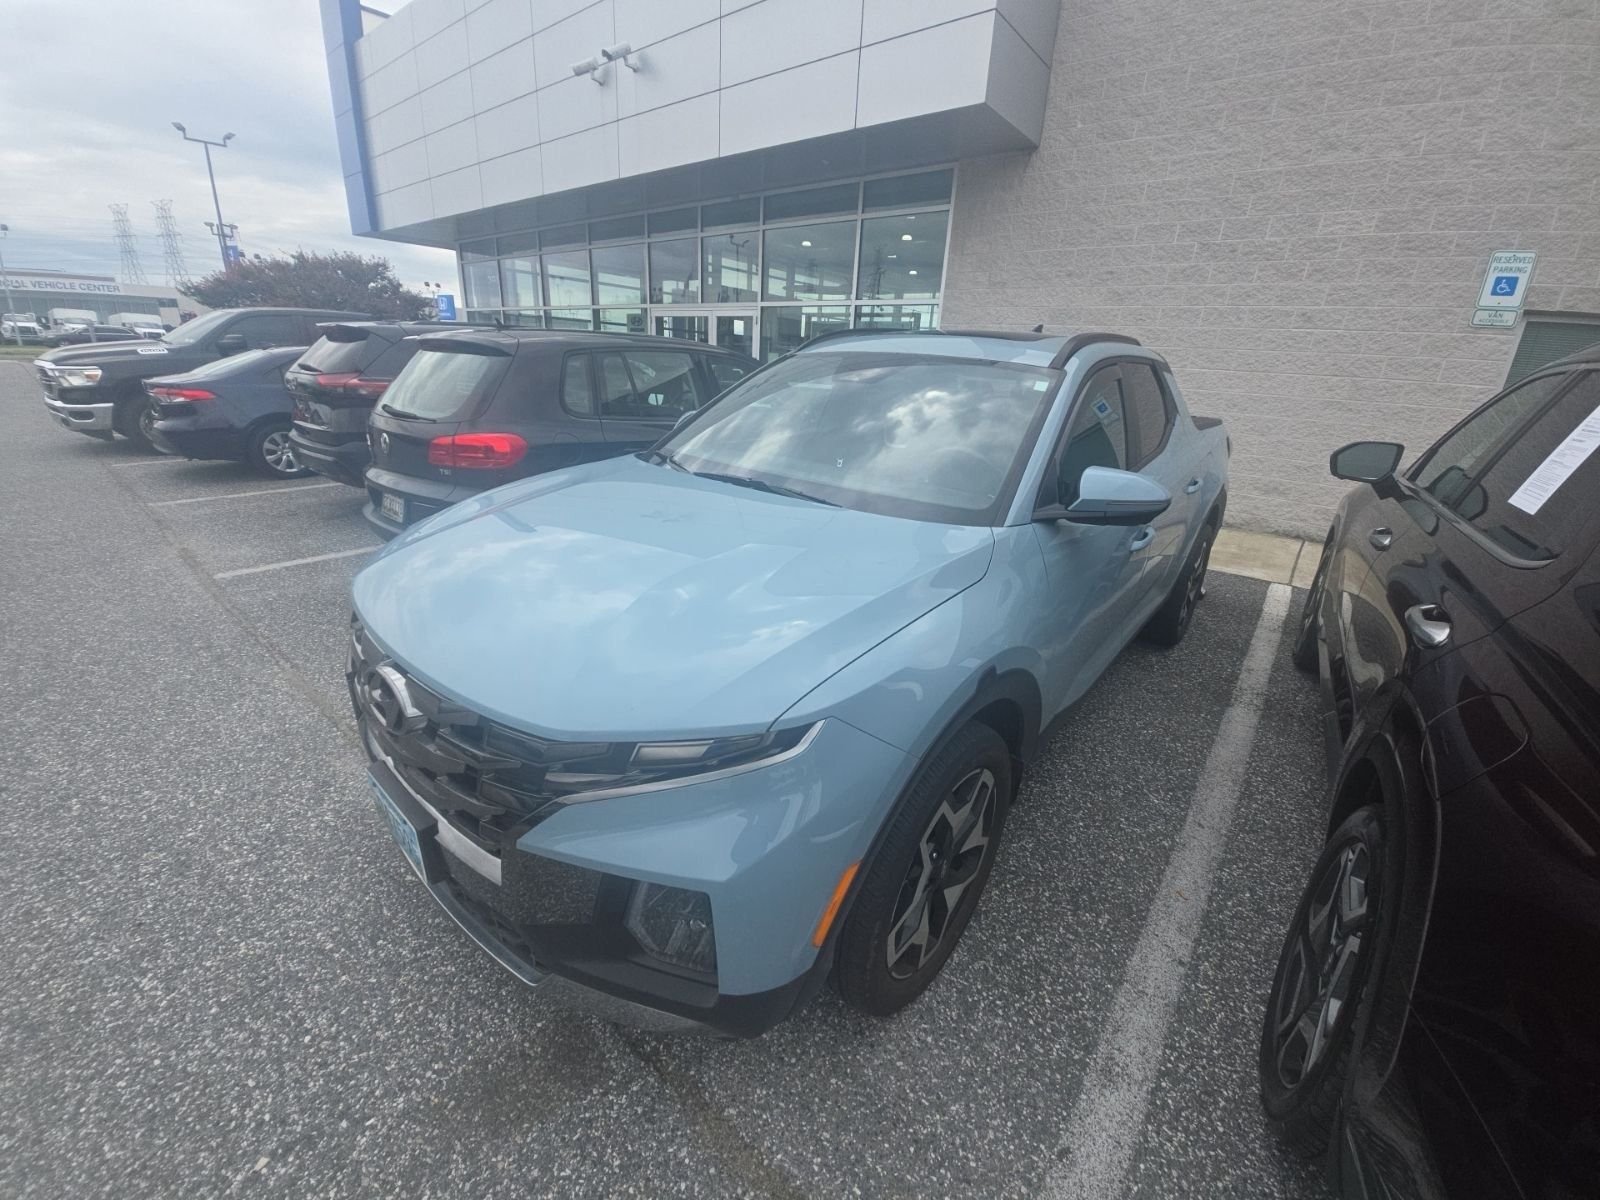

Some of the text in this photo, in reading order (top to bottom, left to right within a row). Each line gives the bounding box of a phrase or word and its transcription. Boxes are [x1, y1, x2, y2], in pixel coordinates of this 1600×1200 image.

[1493, 256, 1534, 264] RESERVED
[30, 280, 76, 290] VEHICLE
[78, 283, 121, 293] CENTER
